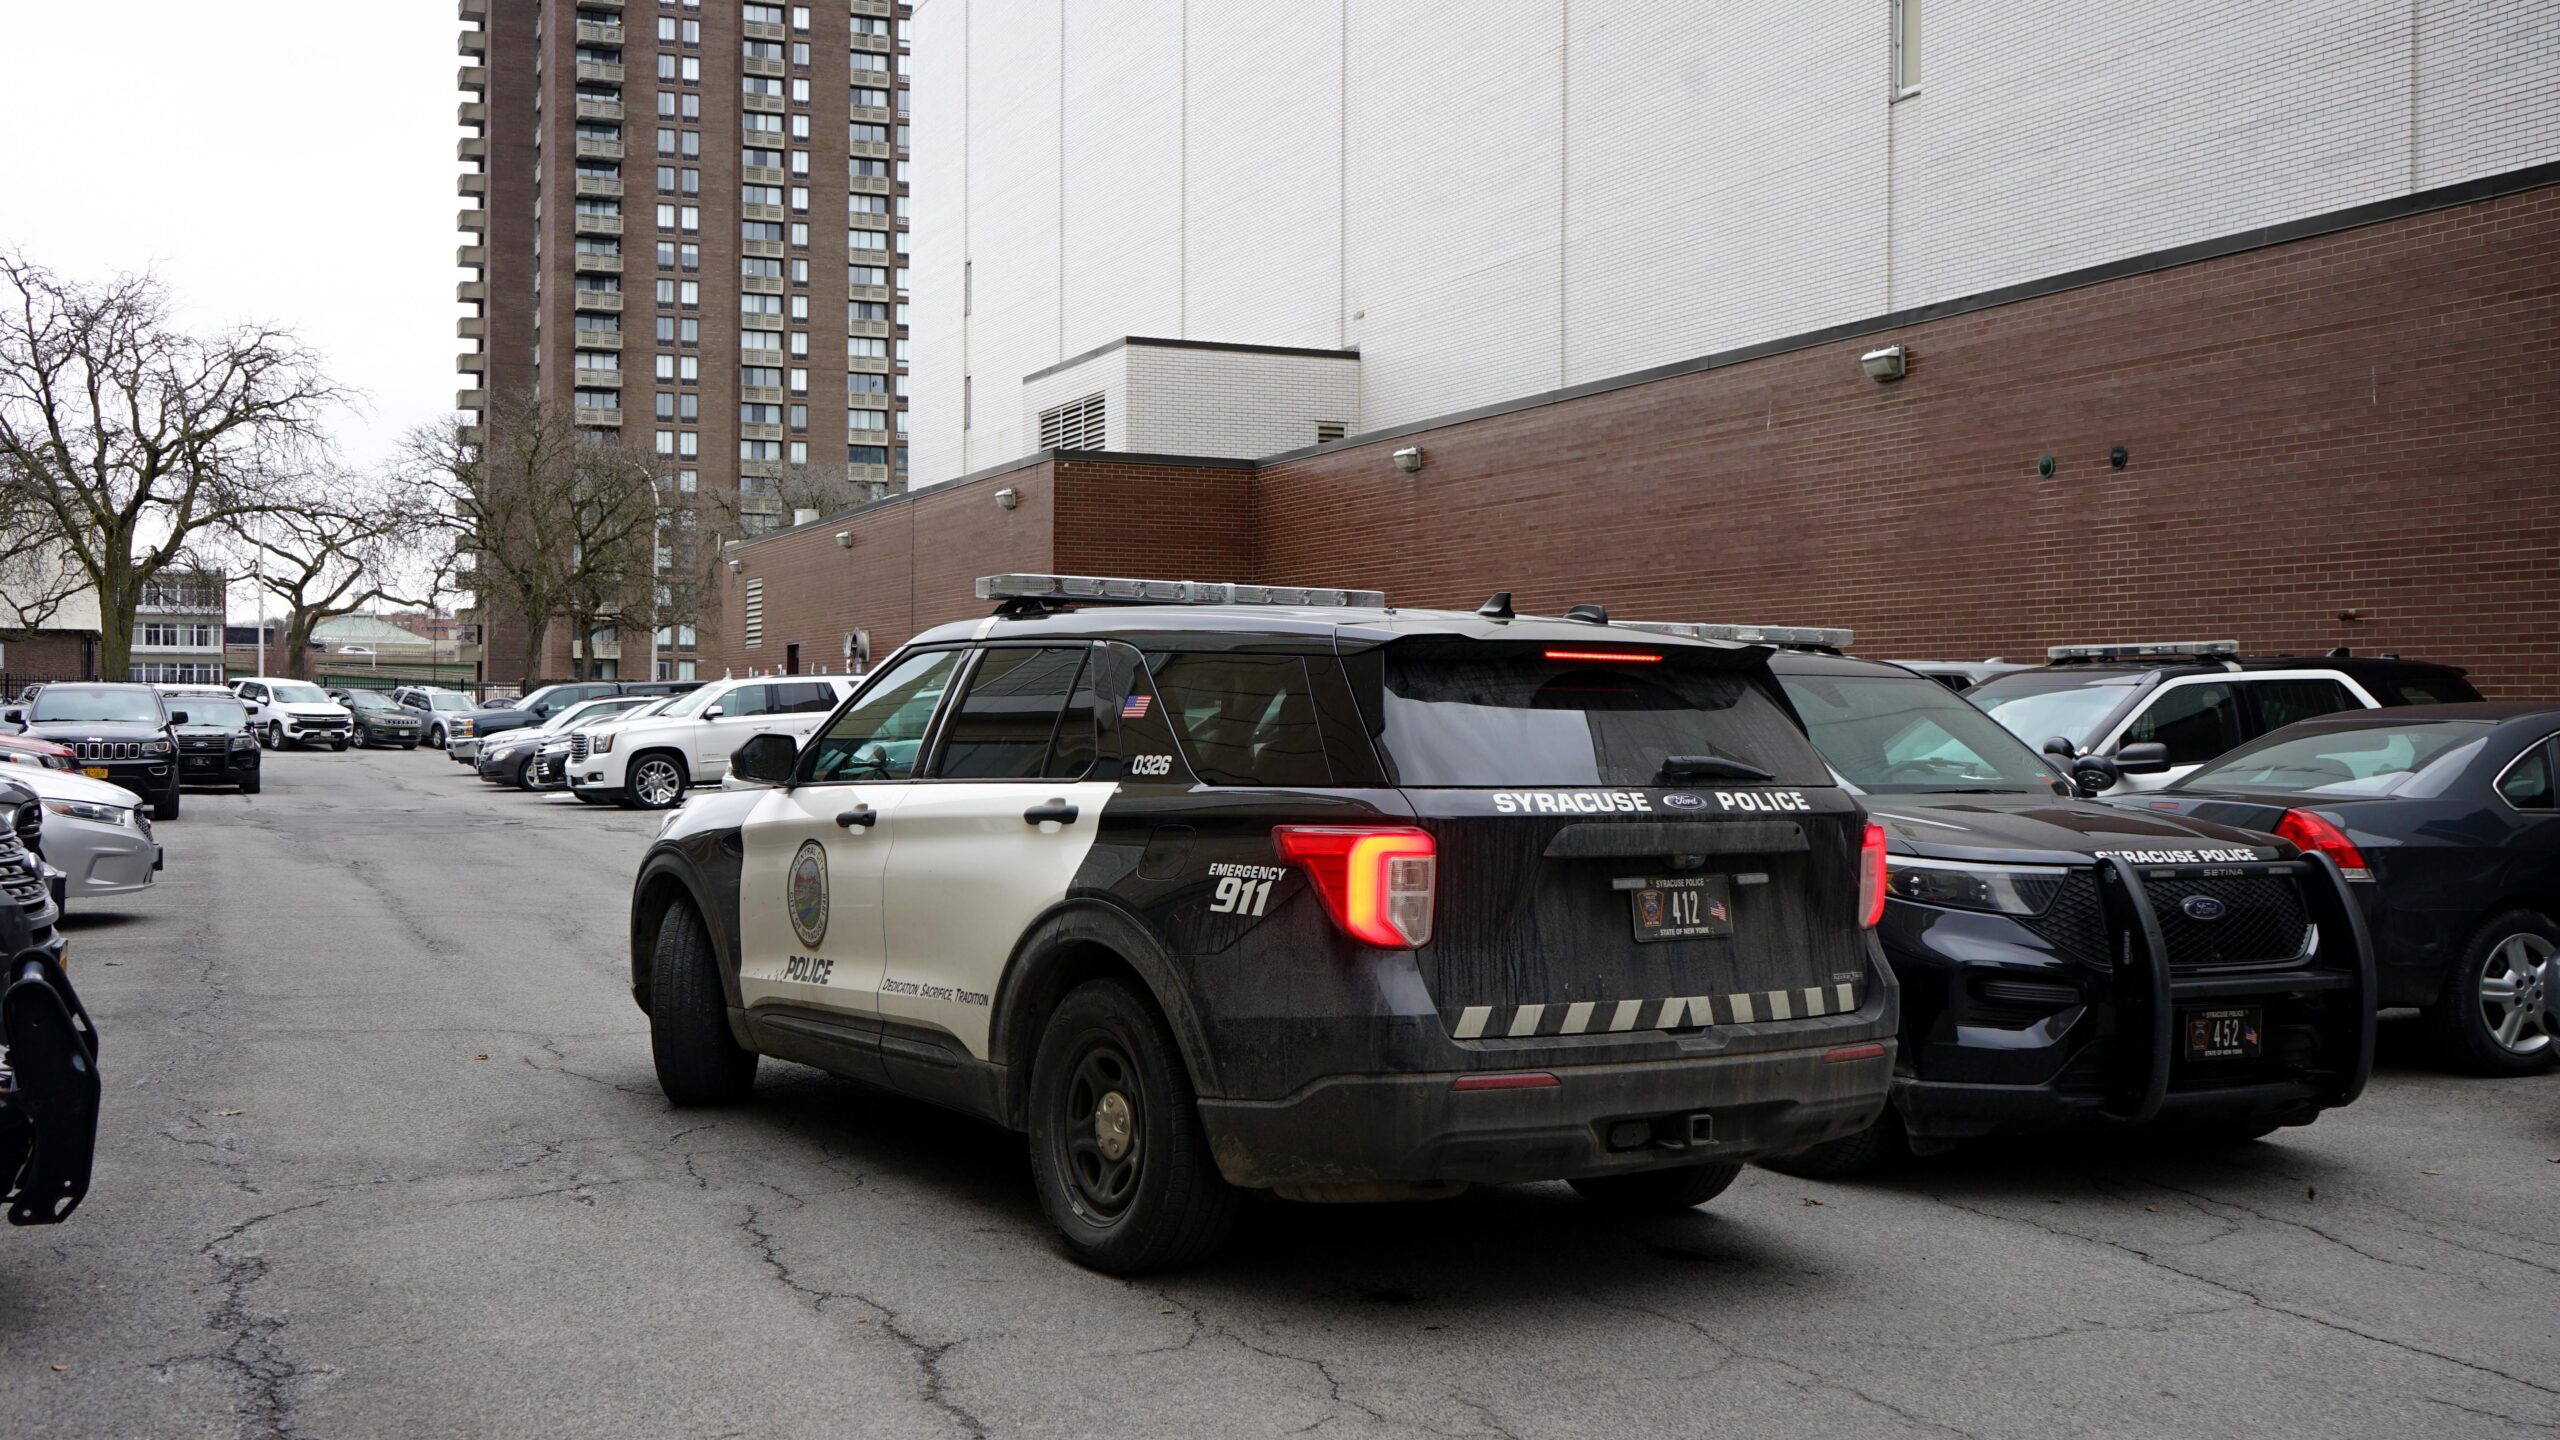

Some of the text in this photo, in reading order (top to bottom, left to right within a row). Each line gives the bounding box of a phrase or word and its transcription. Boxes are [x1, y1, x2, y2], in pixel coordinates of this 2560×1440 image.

[1132, 755, 1172, 775] 0326
[1493, 791, 1811, 812] SYRACUSE POLICE
[1674, 795, 1699, 806] Ford
[2200, 849, 2259, 862] POLICE
[1208, 863, 1287, 881] EMERGENCY
[2203, 869, 2244, 877] SETINA
[1655, 878, 1704, 888] SYRACUSE POLICE
[1210, 877, 1273, 917] 911
[1672, 890, 1700, 925] 412
[1660, 928, 1676, 936] STATE
[1683, 927, 1695, 935] NEW
[1695, 926, 1709, 934] YORK
[784, 955, 834, 985] POLICE
[920, 983, 953, 1004] SACRIFICE,
[955, 988, 989, 1006] TRADITION
[2213, 1019, 2239, 1048] 452
